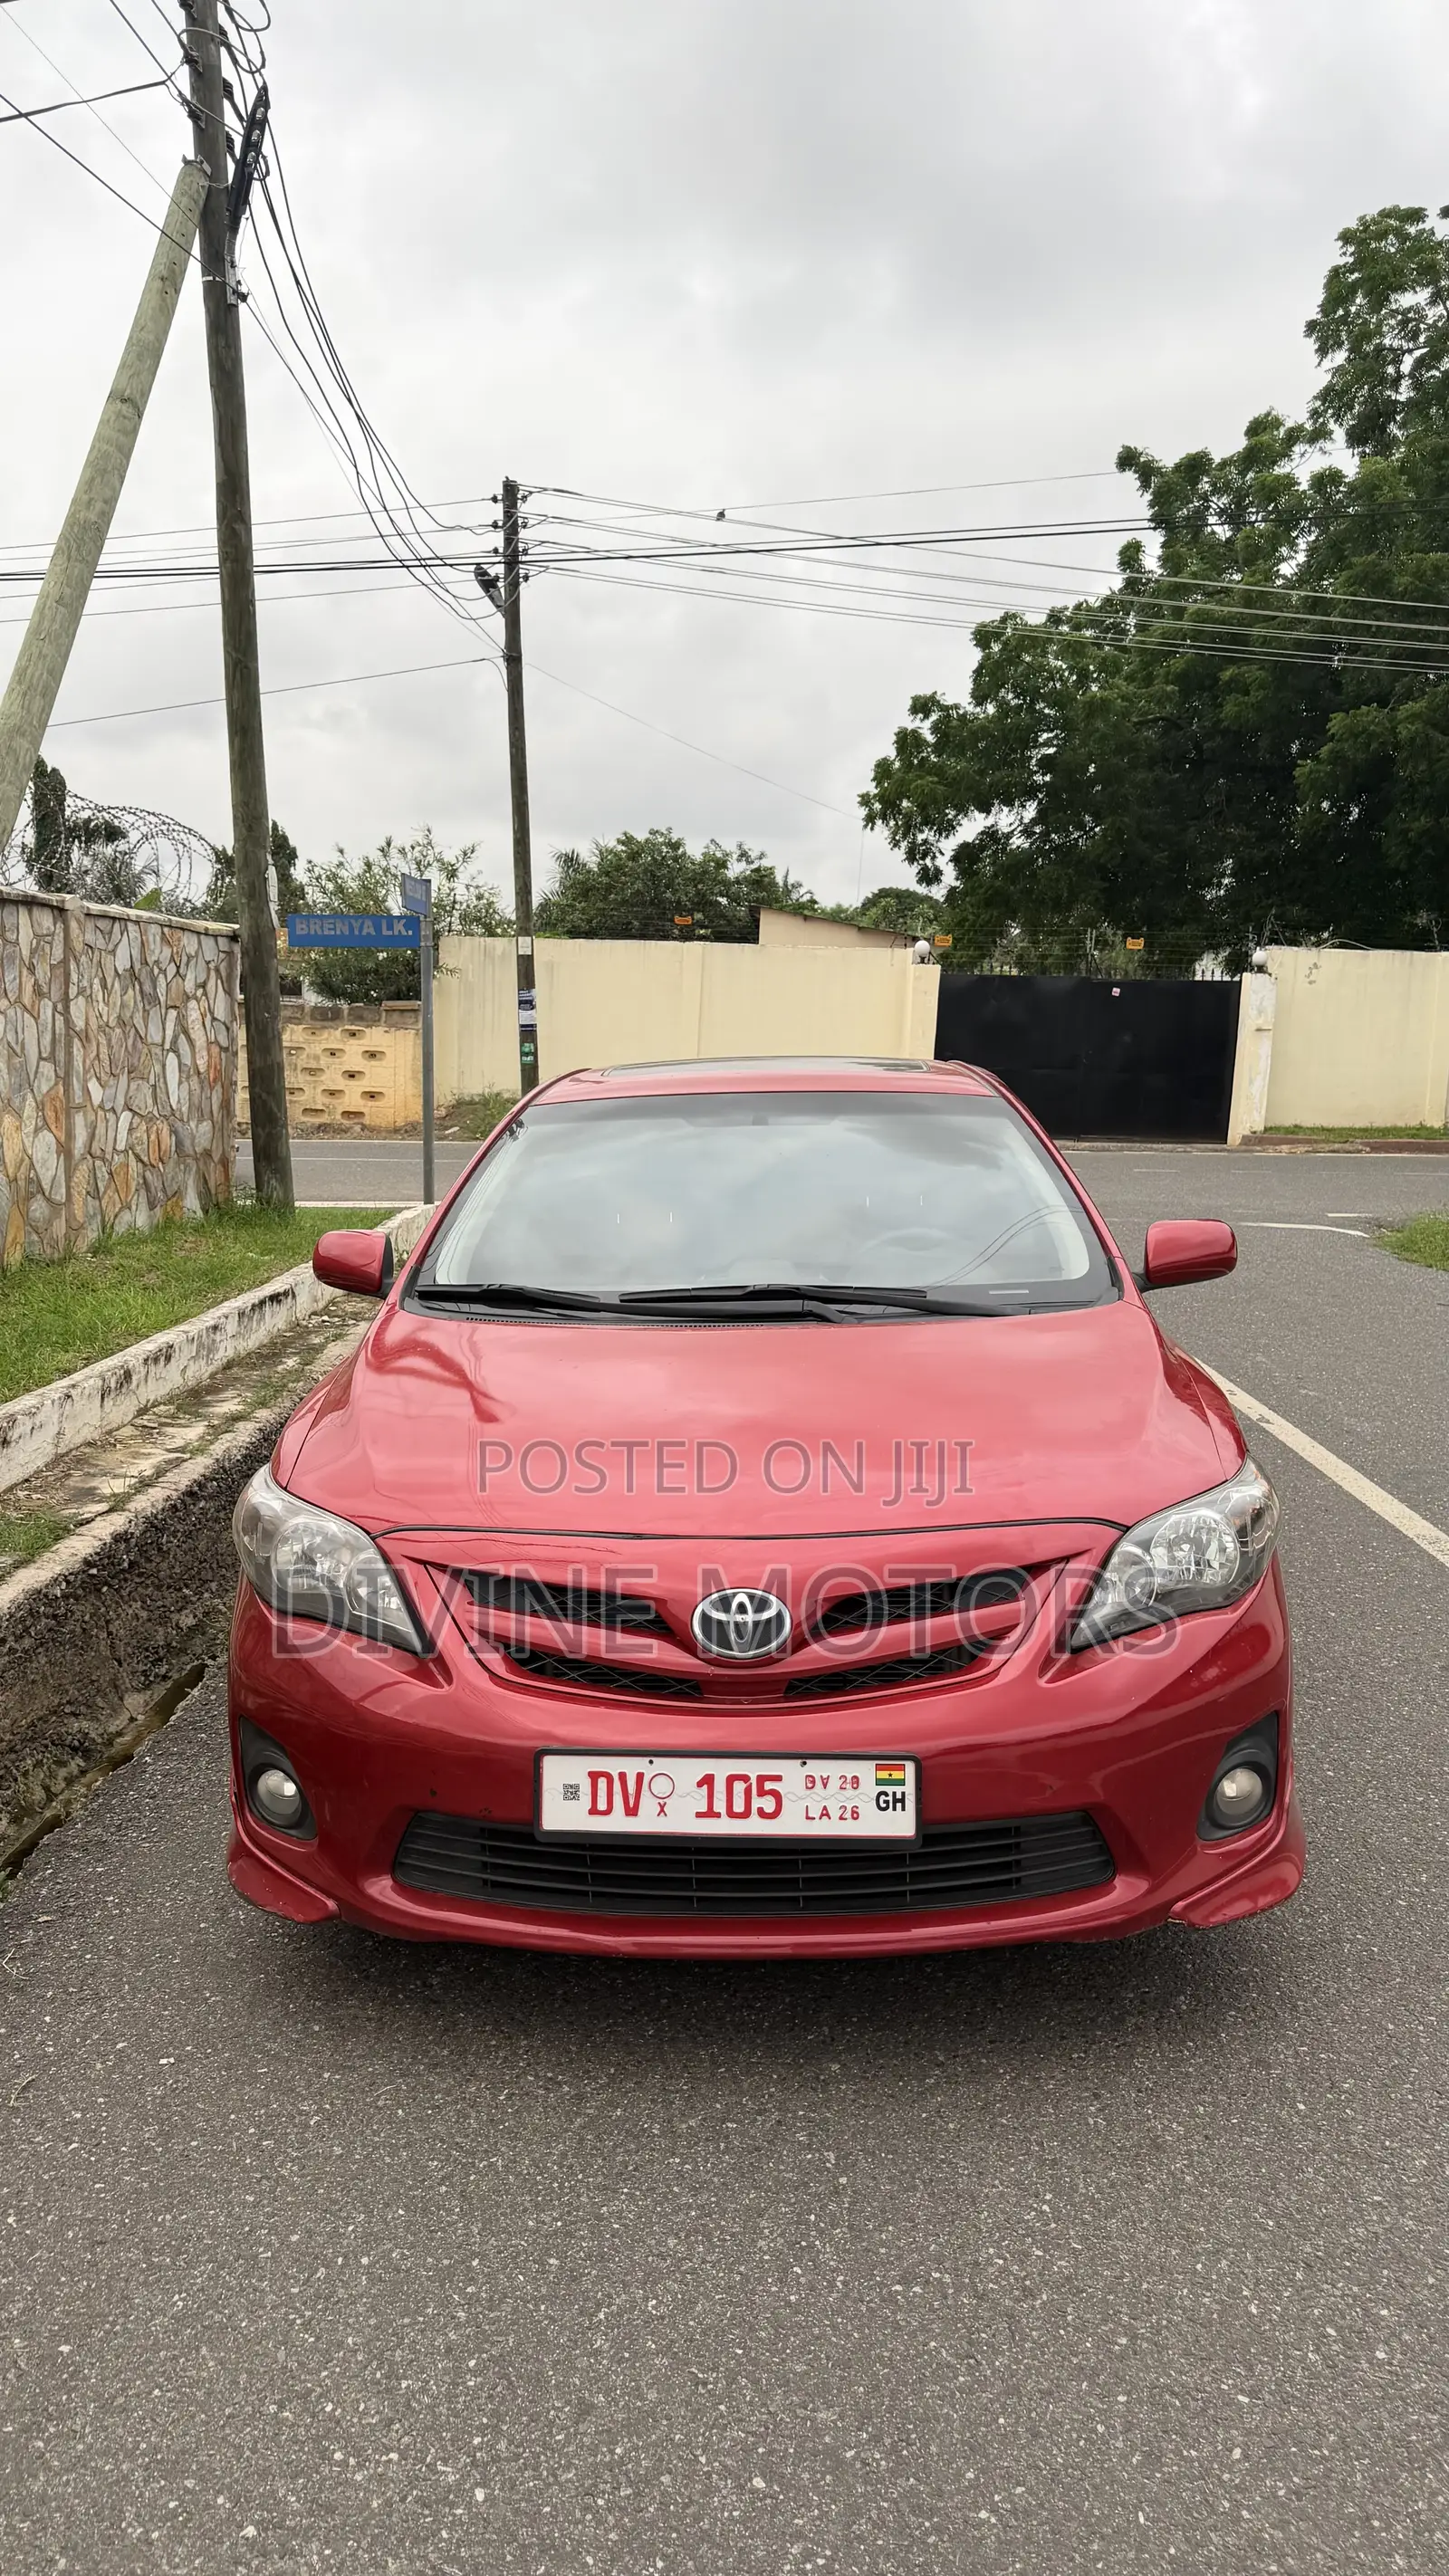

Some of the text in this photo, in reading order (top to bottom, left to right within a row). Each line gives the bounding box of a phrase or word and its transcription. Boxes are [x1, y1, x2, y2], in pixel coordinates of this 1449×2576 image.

[295, 918, 413, 935] BRENYA LK.
[587, 1770, 783, 1819] DV 105
[875, 1790, 906, 1812] GH
[804, 1805, 860, 1821] LA 26
